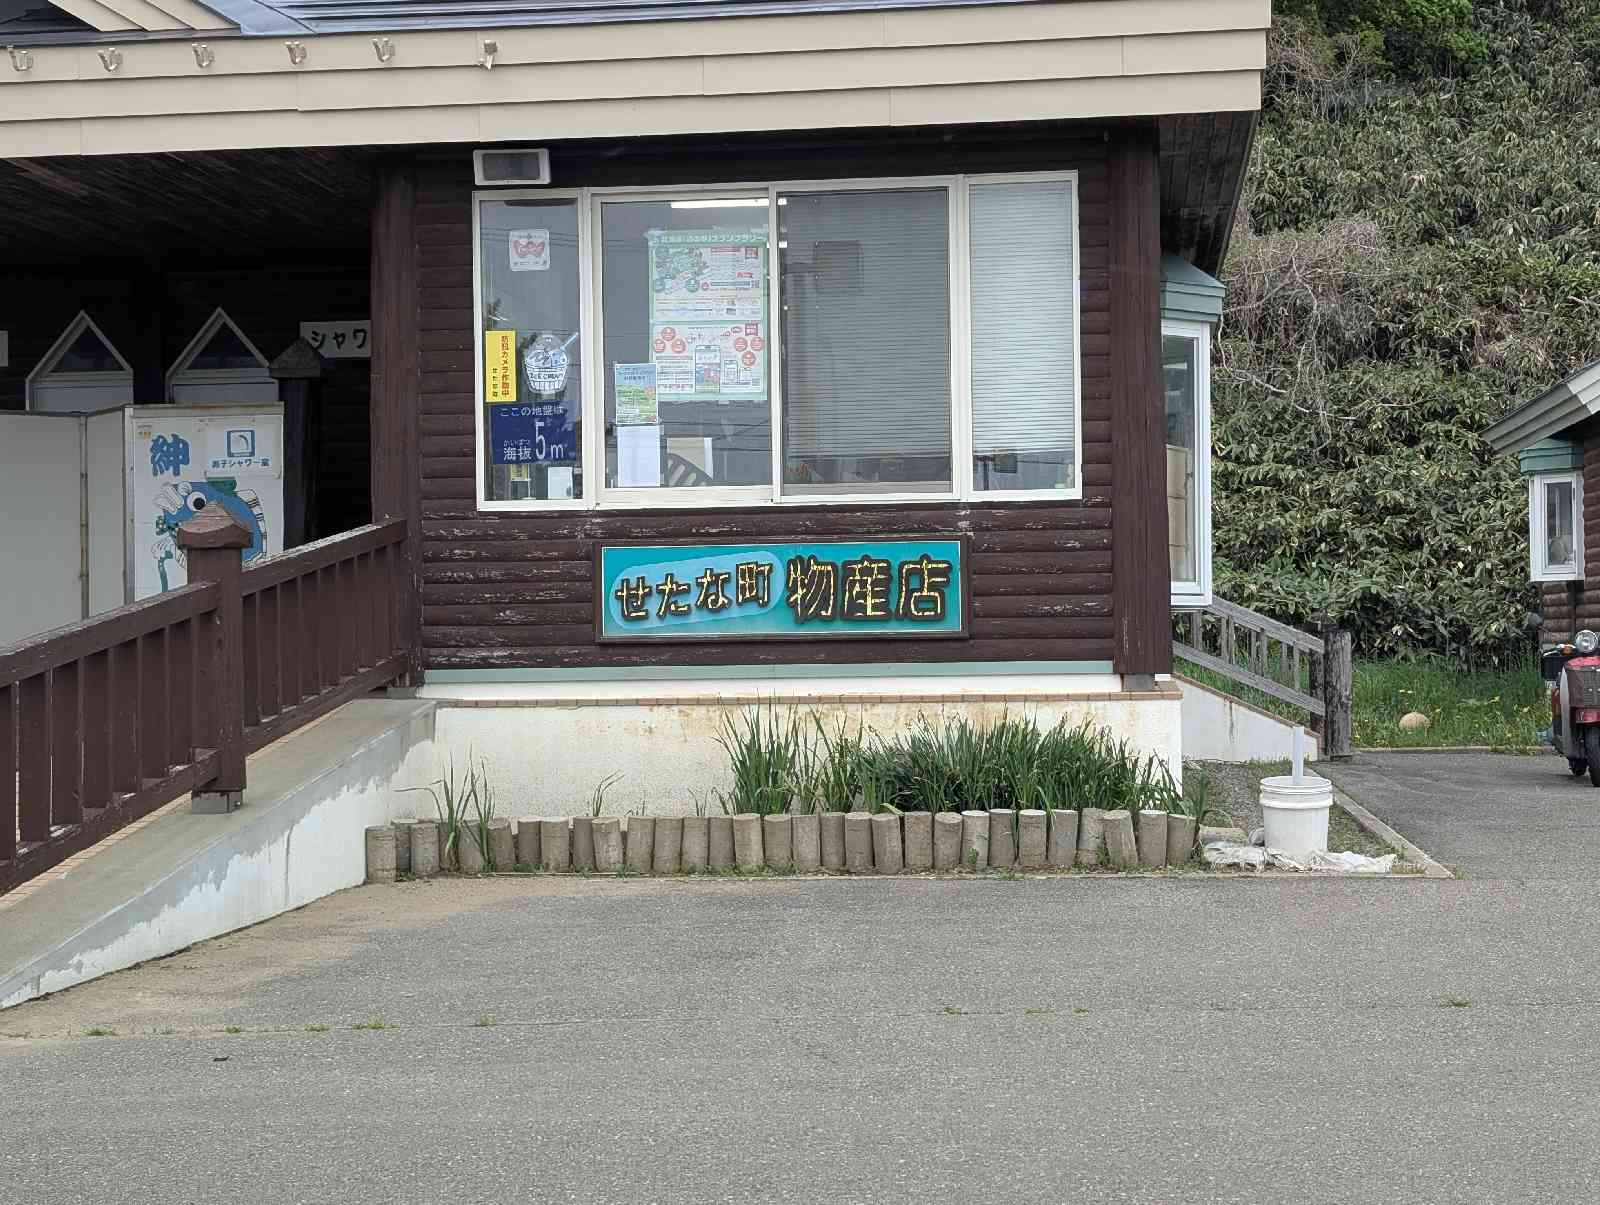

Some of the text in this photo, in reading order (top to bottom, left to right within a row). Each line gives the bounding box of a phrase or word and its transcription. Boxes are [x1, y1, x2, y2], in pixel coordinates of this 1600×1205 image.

[500, 406, 564, 417] ここの地盤は
